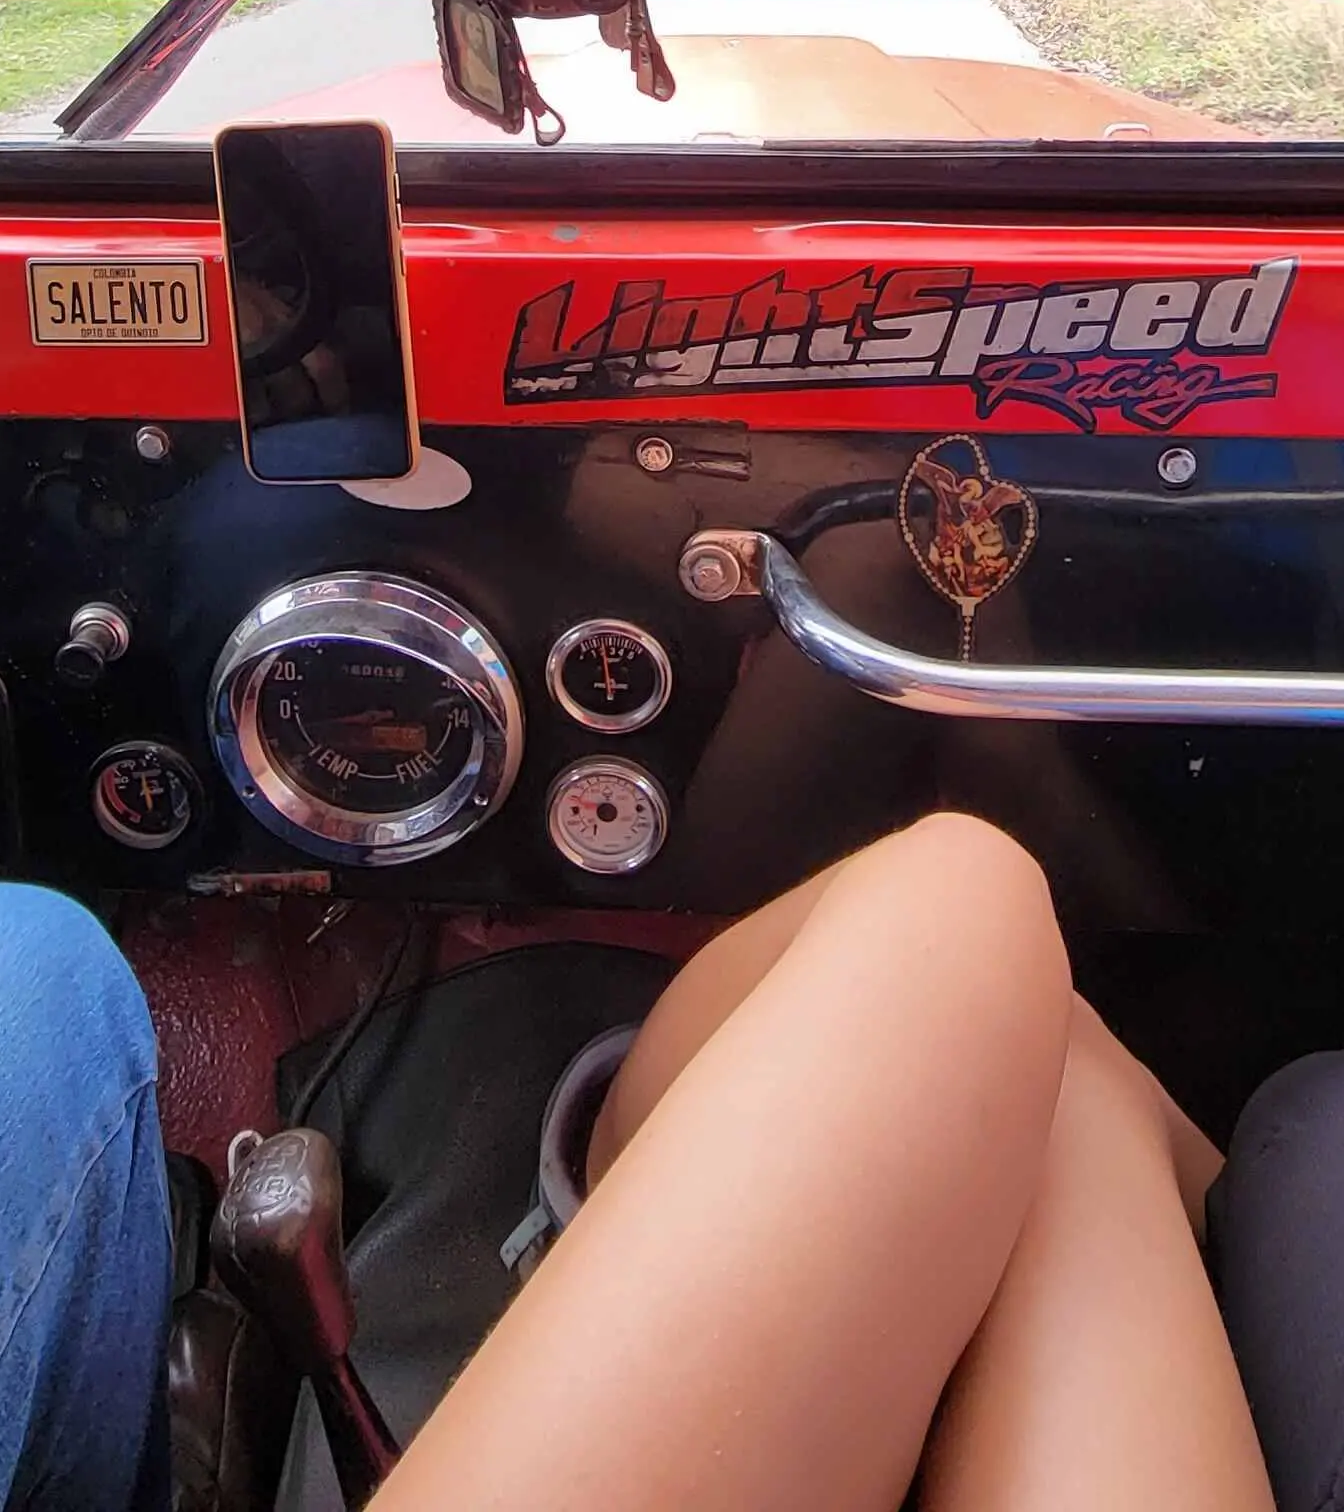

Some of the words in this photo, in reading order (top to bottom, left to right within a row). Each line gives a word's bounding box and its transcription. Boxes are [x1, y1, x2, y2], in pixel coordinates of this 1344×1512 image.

[93, 268, 136, 278] COLOMBIA
[48, 281, 188, 324] SALENTO
[106, 328, 117, 337] DE
[974, 355, 1279, 433] Racing
[274, 660, 297, 682] 20
[308, 745, 360, 780] TEMP
[395, 748, 444, 785] FUEL
